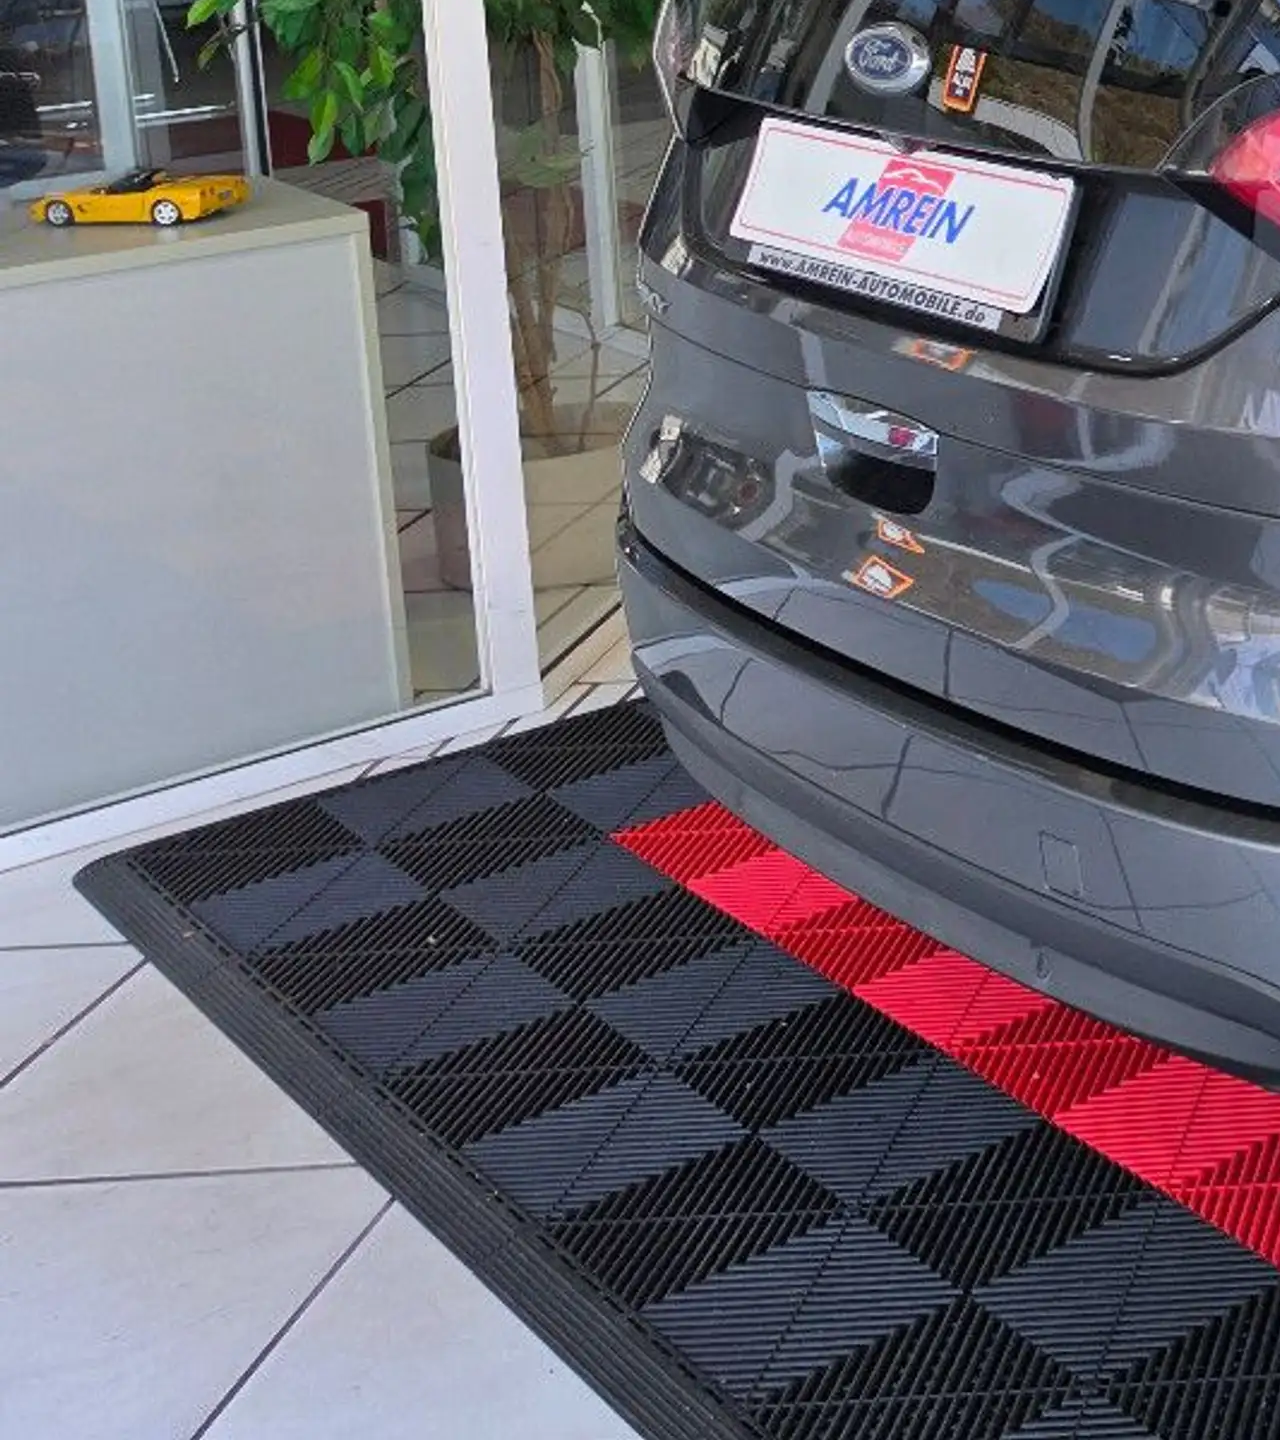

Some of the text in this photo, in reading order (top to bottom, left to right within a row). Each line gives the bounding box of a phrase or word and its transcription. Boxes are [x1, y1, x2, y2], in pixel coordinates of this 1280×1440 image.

[858, 38, 901, 73] Ford
[822, 177, 975, 244] AMREIN
[760, 251, 986, 323] www.AMREIN-AUTOMOBILE.de
